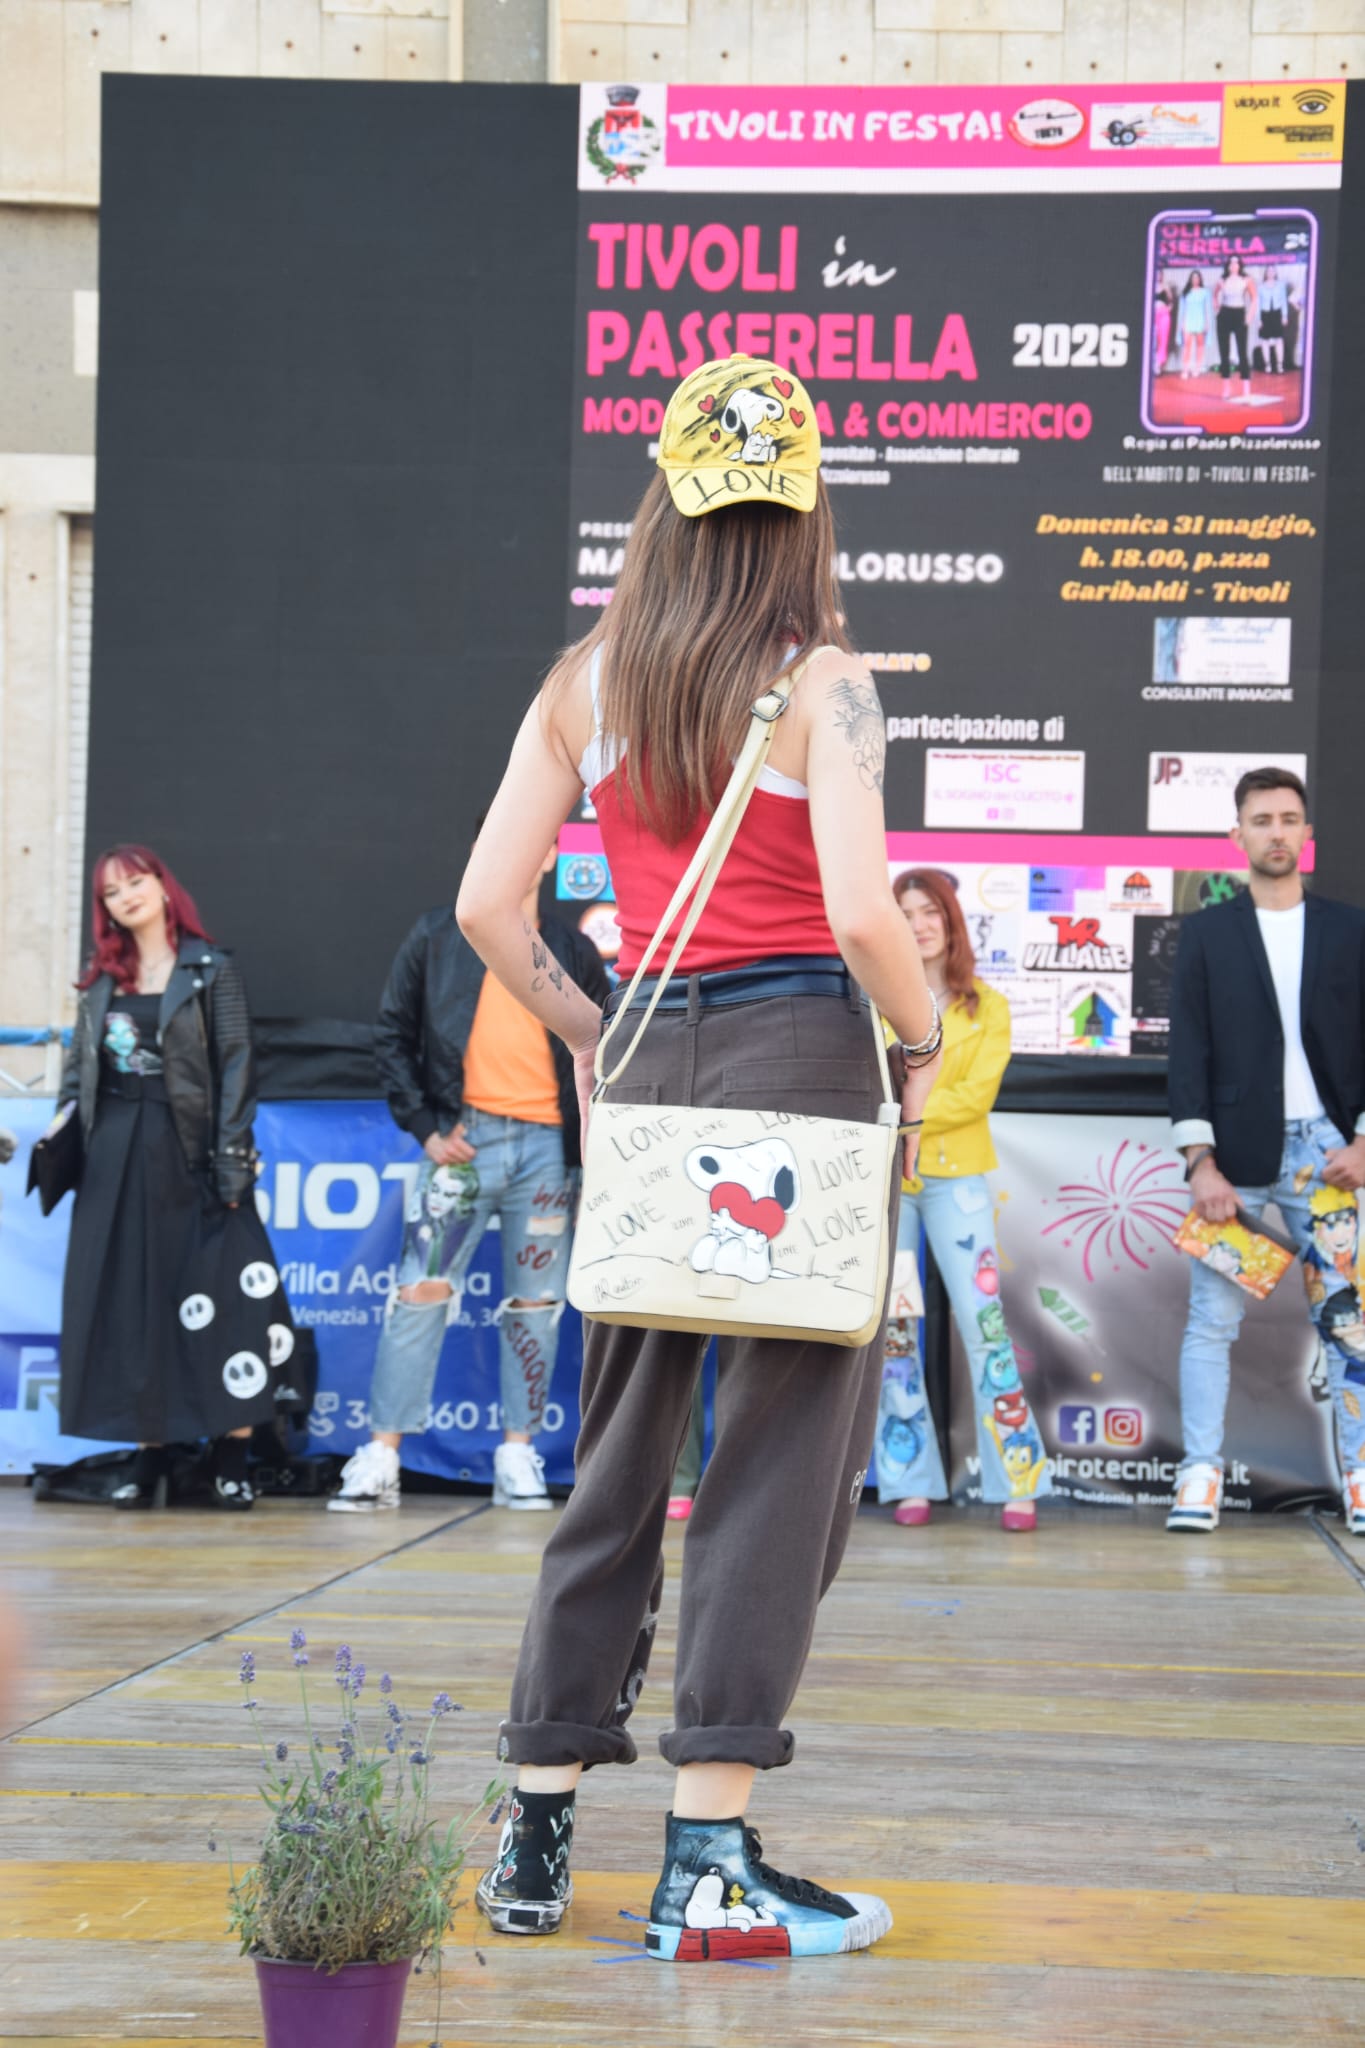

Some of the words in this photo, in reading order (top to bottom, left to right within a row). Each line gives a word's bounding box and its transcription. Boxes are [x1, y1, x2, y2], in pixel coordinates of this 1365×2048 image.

[669, 109, 805, 141] TIVOLI
[812, 110, 857, 141] IN
[863, 110, 1003, 141] FESTA!
[588, 222, 798, 292] TIVOLI
[821, 235, 897, 287] in
[585, 311, 979, 382] PASSERELLA
[1012, 323, 1129, 367] 2026
[583, 397, 663, 435] MOD
[843, 404, 869, 438] &
[877, 402, 1092, 440] COMMERCIO
[690, 468, 803, 510] LOVE
[1036, 512, 1170, 536] Domenica
[1206, 513, 1317, 540] maggio,
[830, 551, 1004, 584] LORUSSO
[1079, 546, 1106, 569] h.
[1110, 546, 1190, 571] 18.00,
[1059, 579, 1190, 603] Garibaldi
[1211, 579, 1292, 603] Tivoli
[1141, 686, 1225, 700] CONSULENTE
[887, 715, 1039, 744] partecipazione
[1043, 716, 1065, 742] di
[984, 763, 1021, 783] ISC
[1023, 943, 1132, 973] VILLAGE
[610, 1114, 681, 1162] LOVE
[694, 1119, 728, 1139] LOVE
[832, 1128, 864, 1142] LOVE
[811, 1148, 872, 1192] LOVE
[601, 1199, 667, 1249] LOVE
[801, 1202, 875, 1248] LOVE
[292, 1306, 369, 1326] Venezia
